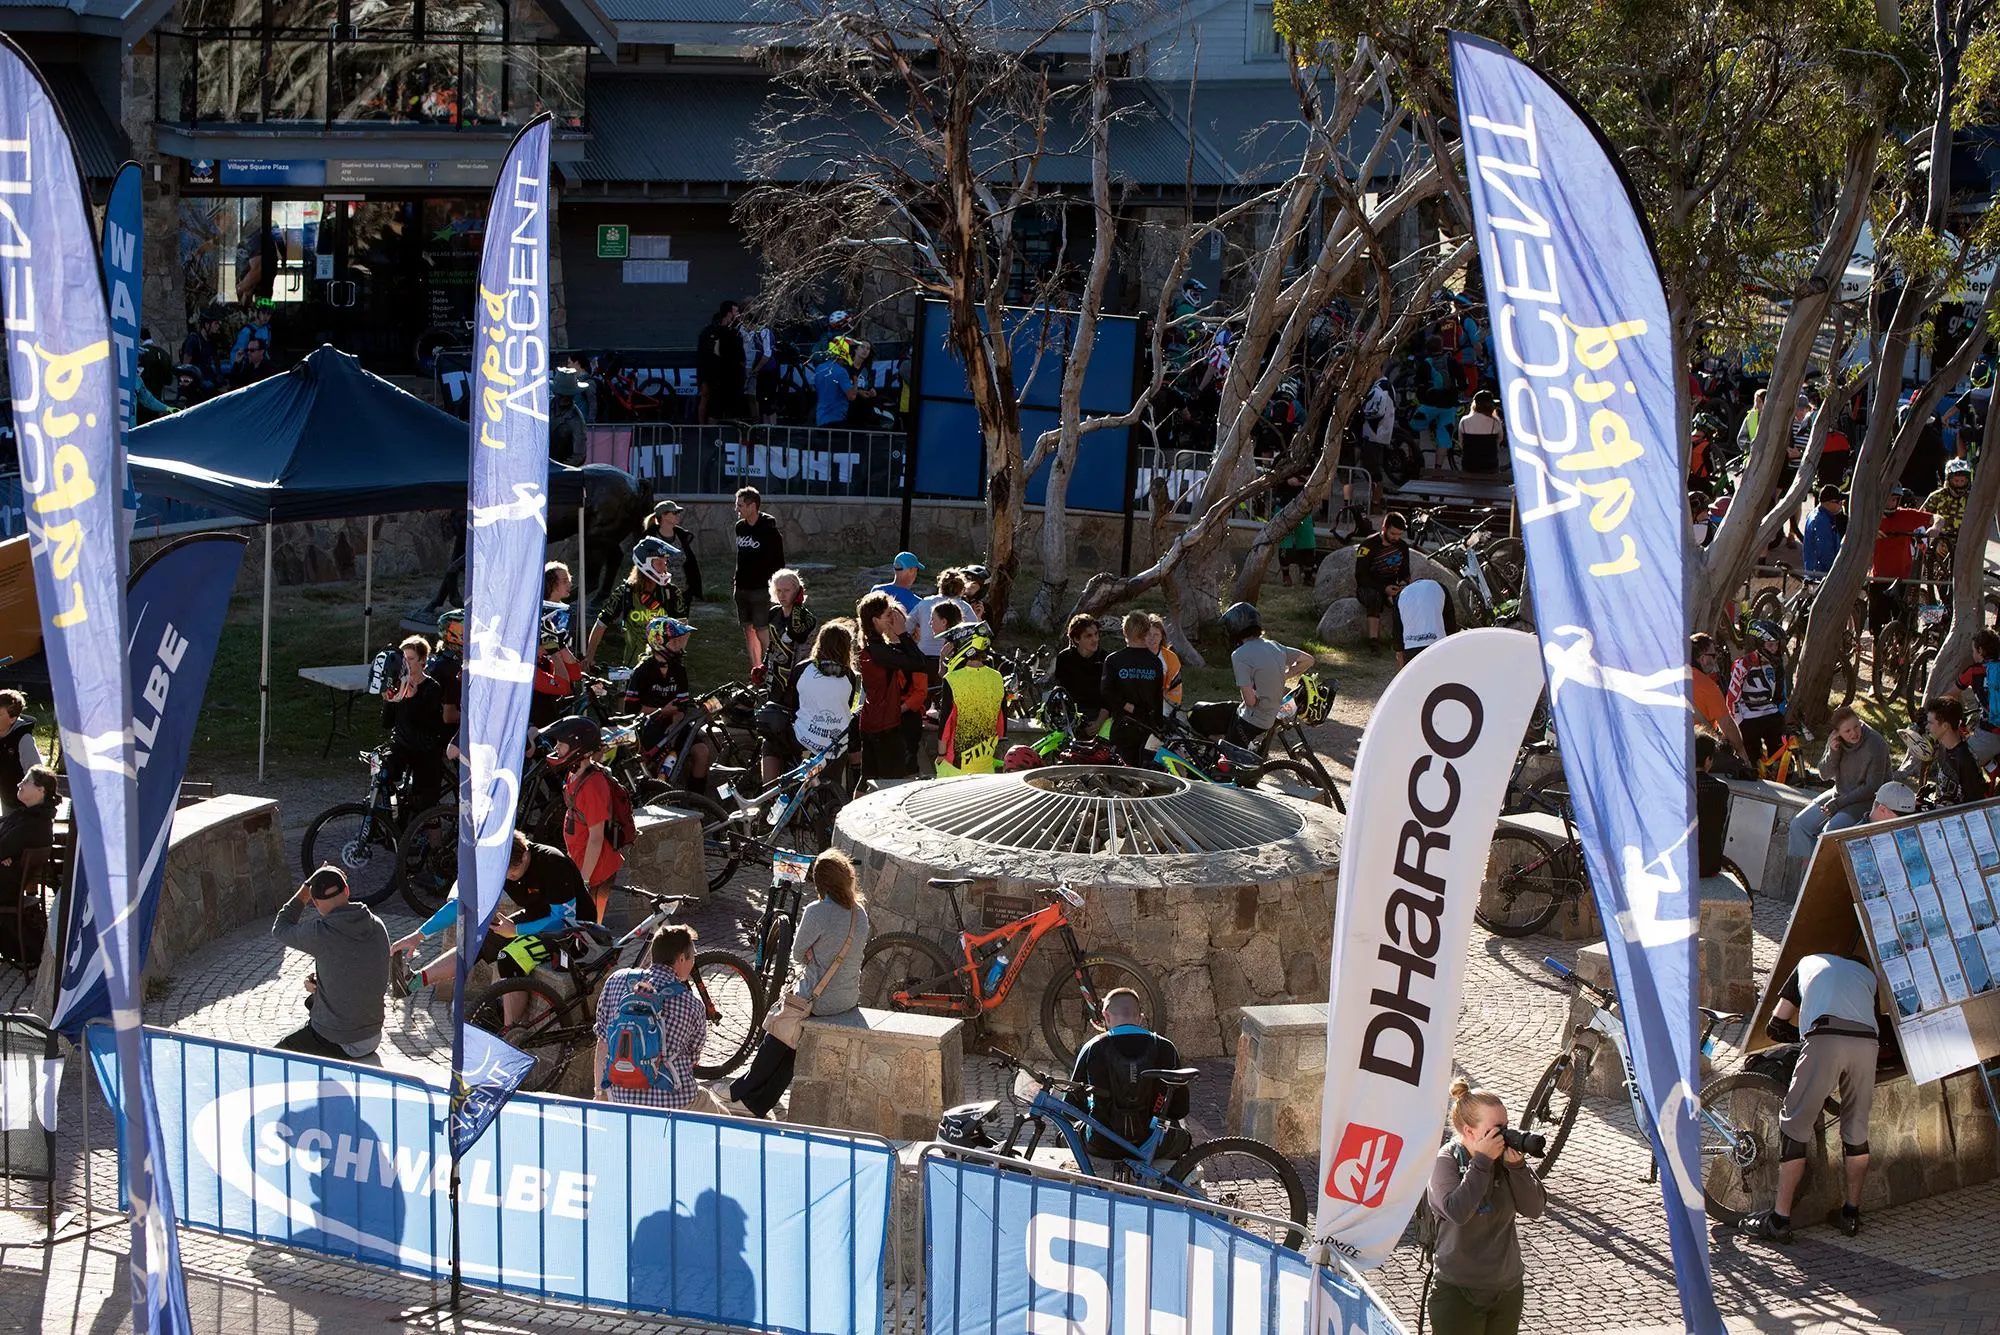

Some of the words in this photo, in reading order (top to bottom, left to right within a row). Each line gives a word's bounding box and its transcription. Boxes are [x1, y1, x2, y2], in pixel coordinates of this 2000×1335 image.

[480, 284, 517, 450] rapid
[506, 160, 549, 422] ASCENT
[255, 1119, 597, 1221] SCHWALBE
